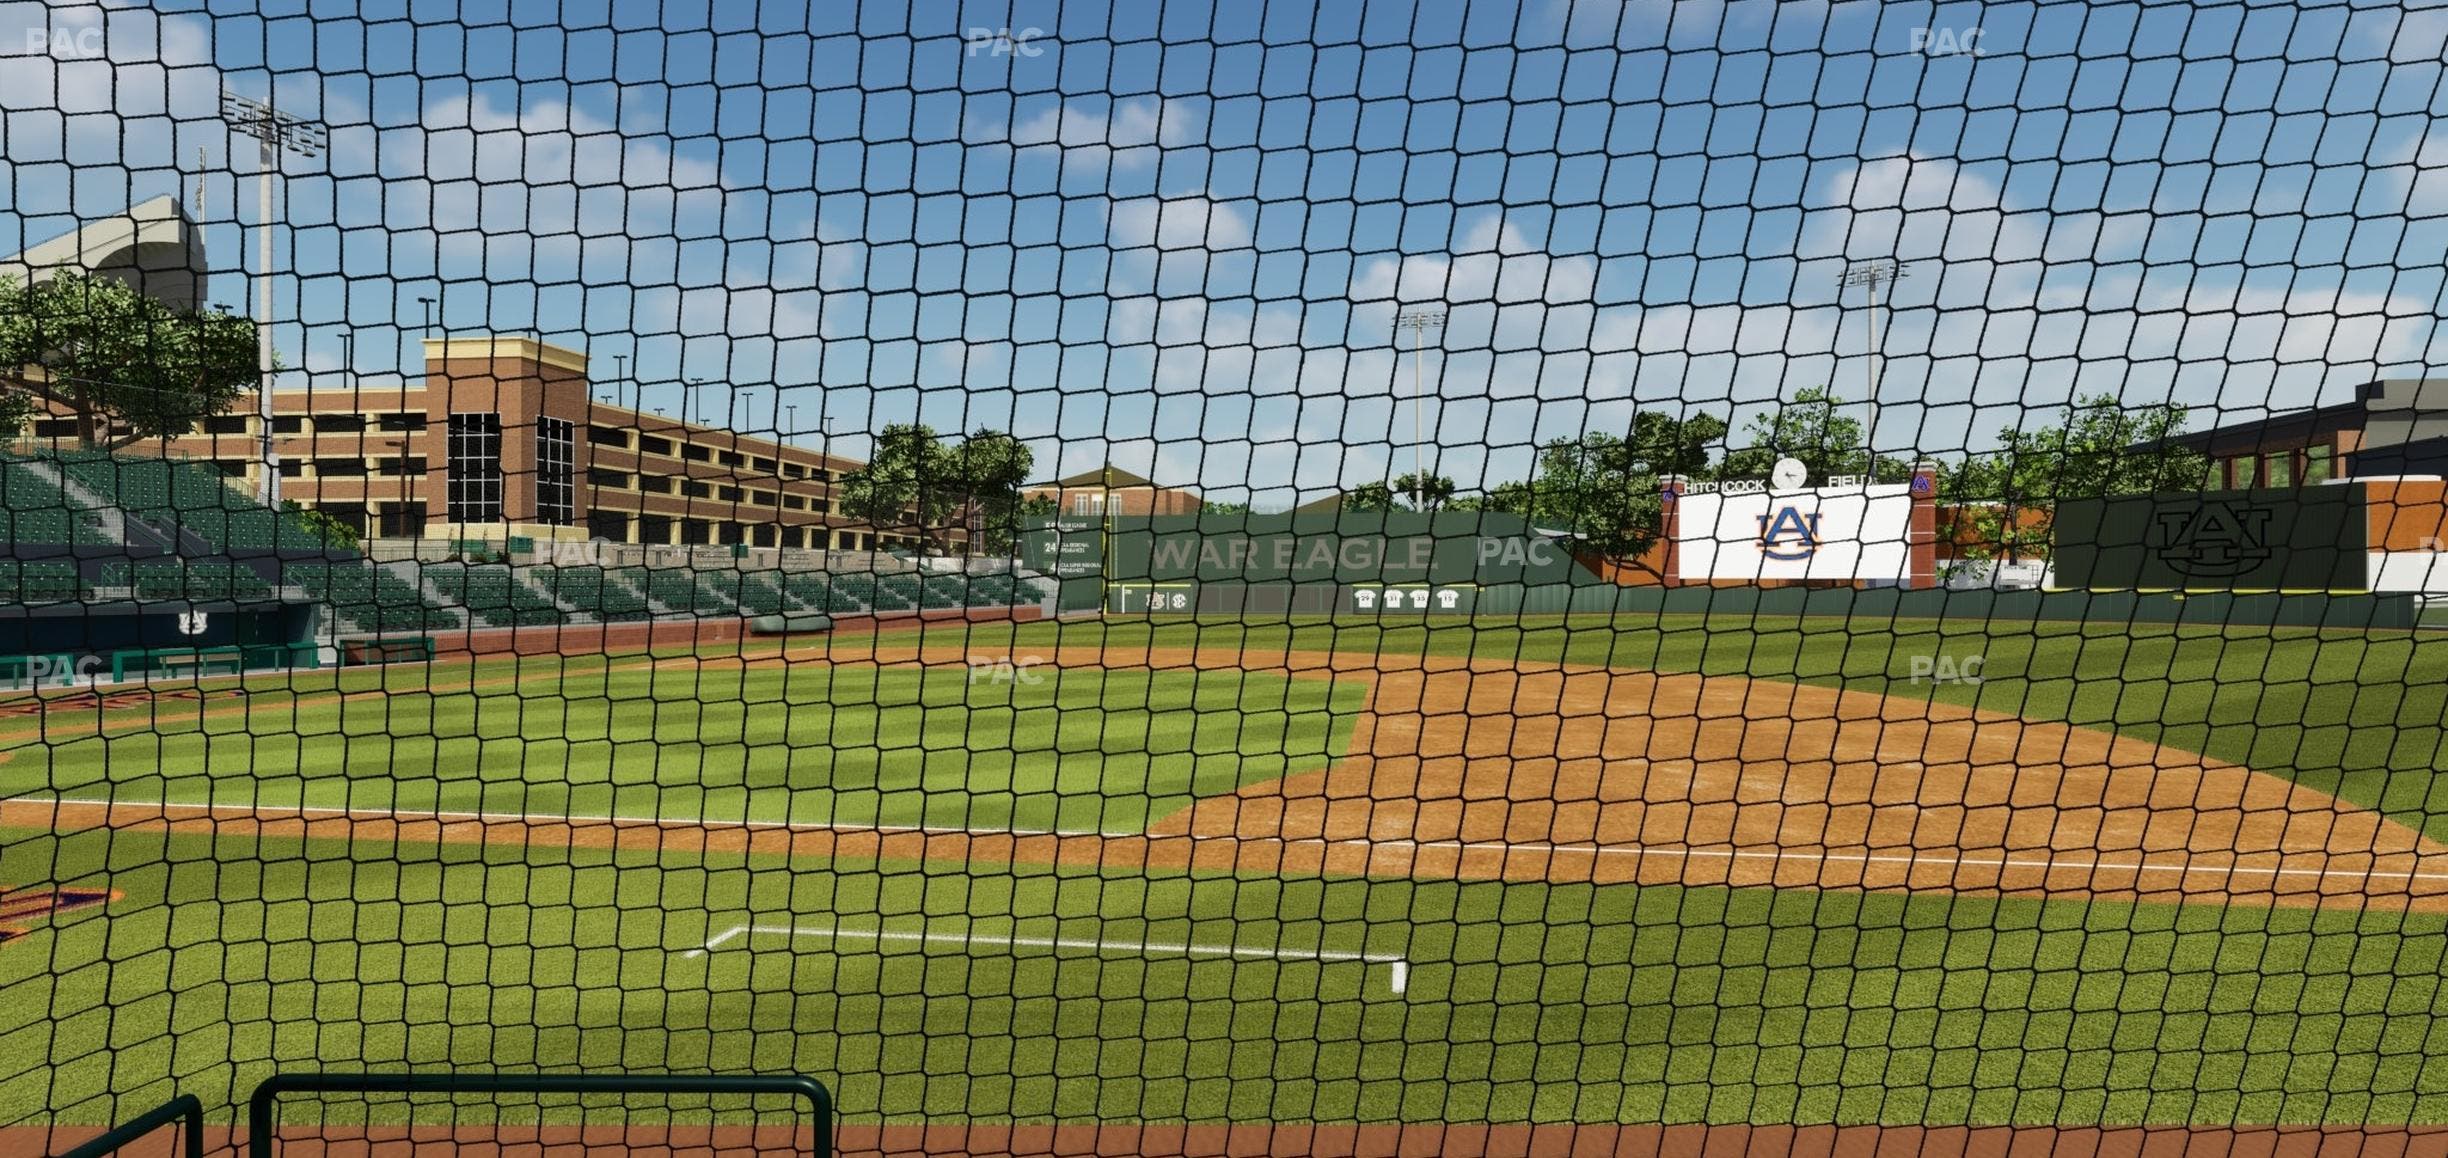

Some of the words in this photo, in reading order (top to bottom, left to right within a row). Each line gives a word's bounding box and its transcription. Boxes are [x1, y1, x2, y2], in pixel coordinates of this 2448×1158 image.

[1685, 479, 1767, 494] HITCHCOCK
[1829, 474, 1872, 487] FIELD
[1045, 542, 1056, 553] 24
[1147, 539, 1259, 570] WAR
[1273, 538, 1439, 570] EAGLE
